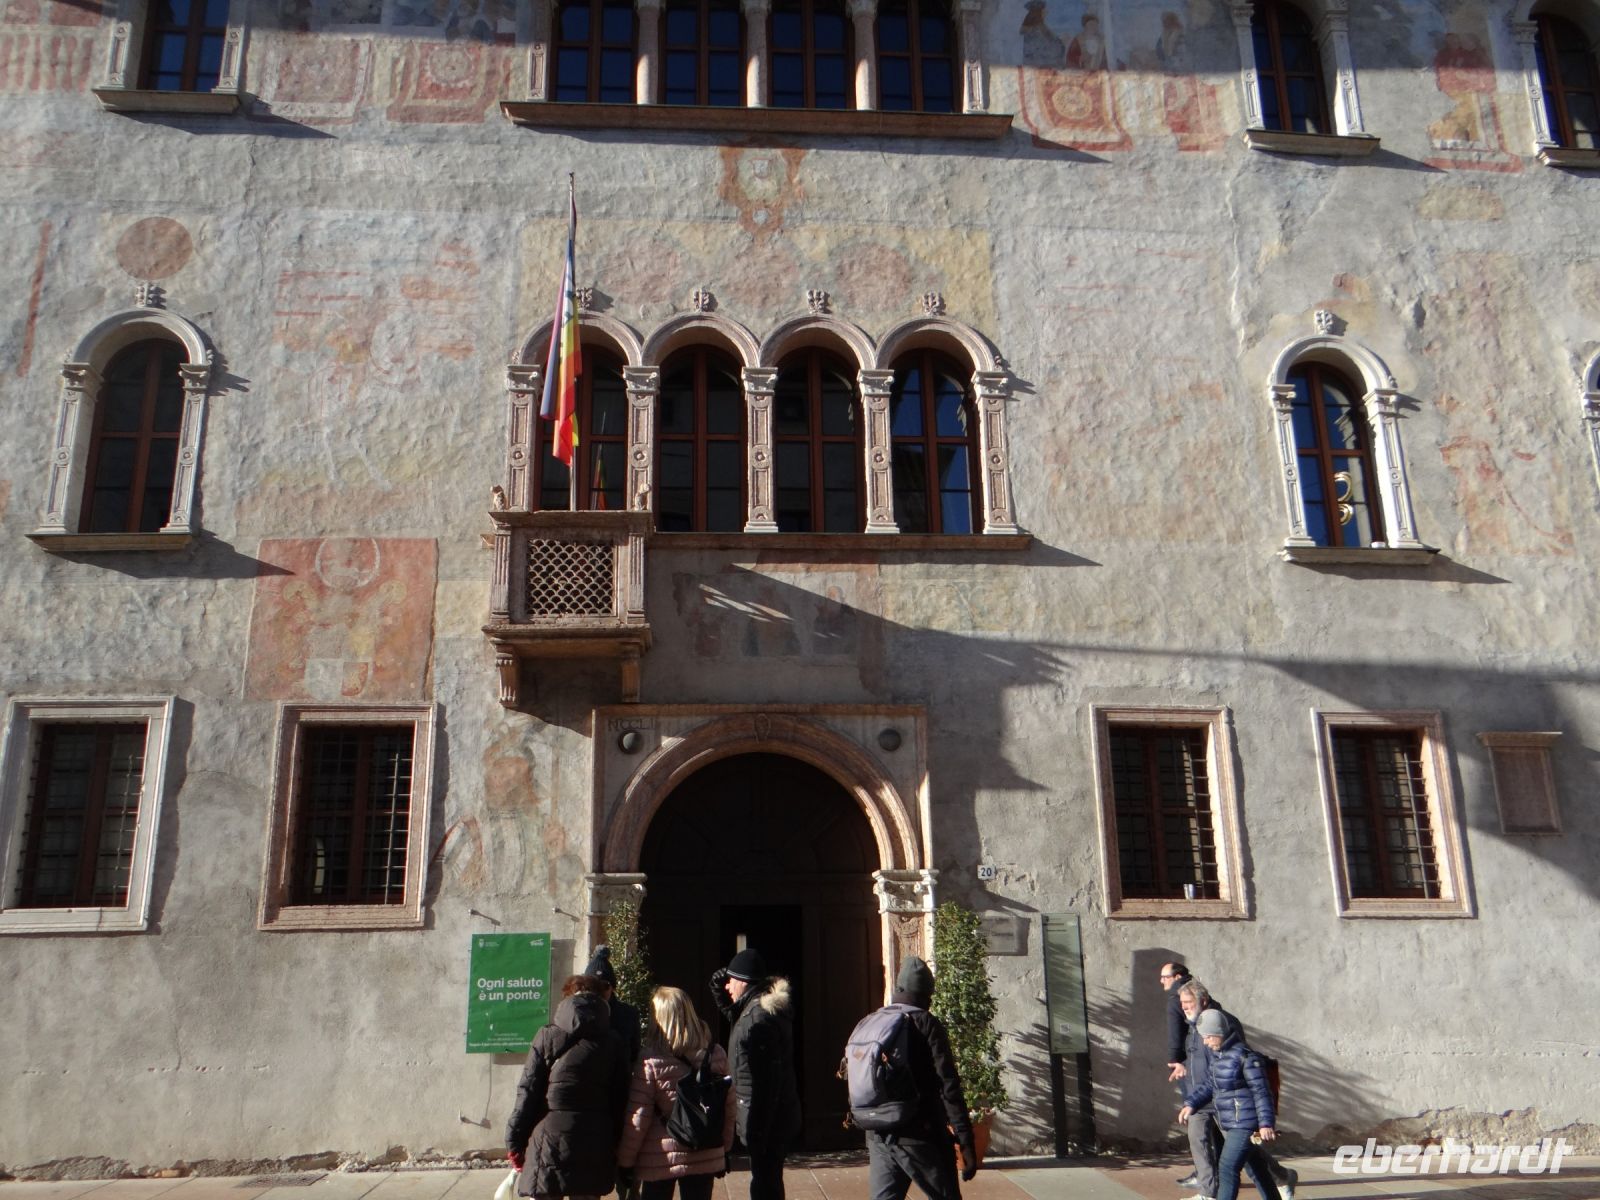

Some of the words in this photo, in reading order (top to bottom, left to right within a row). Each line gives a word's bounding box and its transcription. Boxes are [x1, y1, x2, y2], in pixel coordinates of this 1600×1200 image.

[980, 867, 992, 877] 20
[477, 978, 504, 990] Ogni
[507, 978, 543, 987] saluto
[479, 990, 486, 1000] è
[489, 992, 504, 1000] un
[506, 990, 541, 1002] ponte
